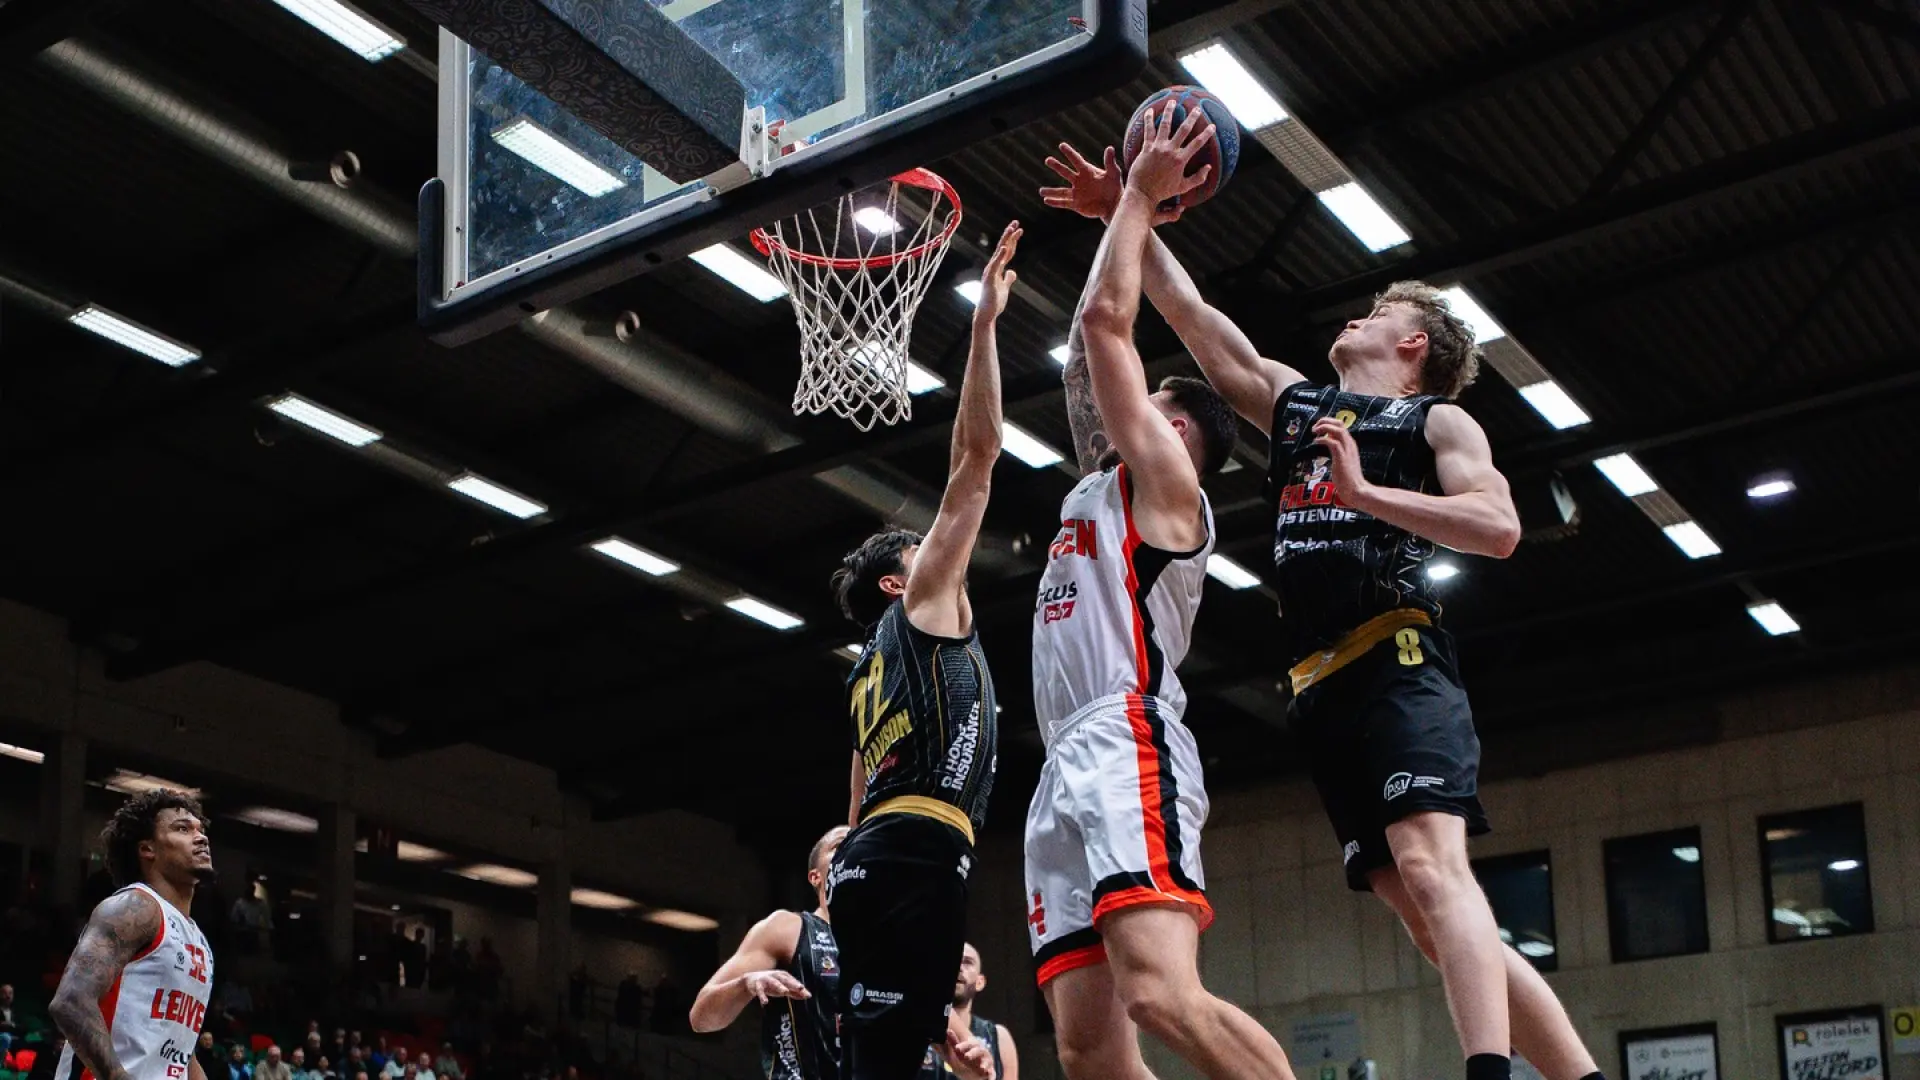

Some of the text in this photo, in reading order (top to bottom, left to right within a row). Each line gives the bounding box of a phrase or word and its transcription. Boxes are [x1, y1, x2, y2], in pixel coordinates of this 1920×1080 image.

[1280, 481, 1347, 512] FILO
[1395, 628, 1424, 666] 8
[851, 651, 892, 748] 22
[951, 700, 980, 791] INSURANCE
